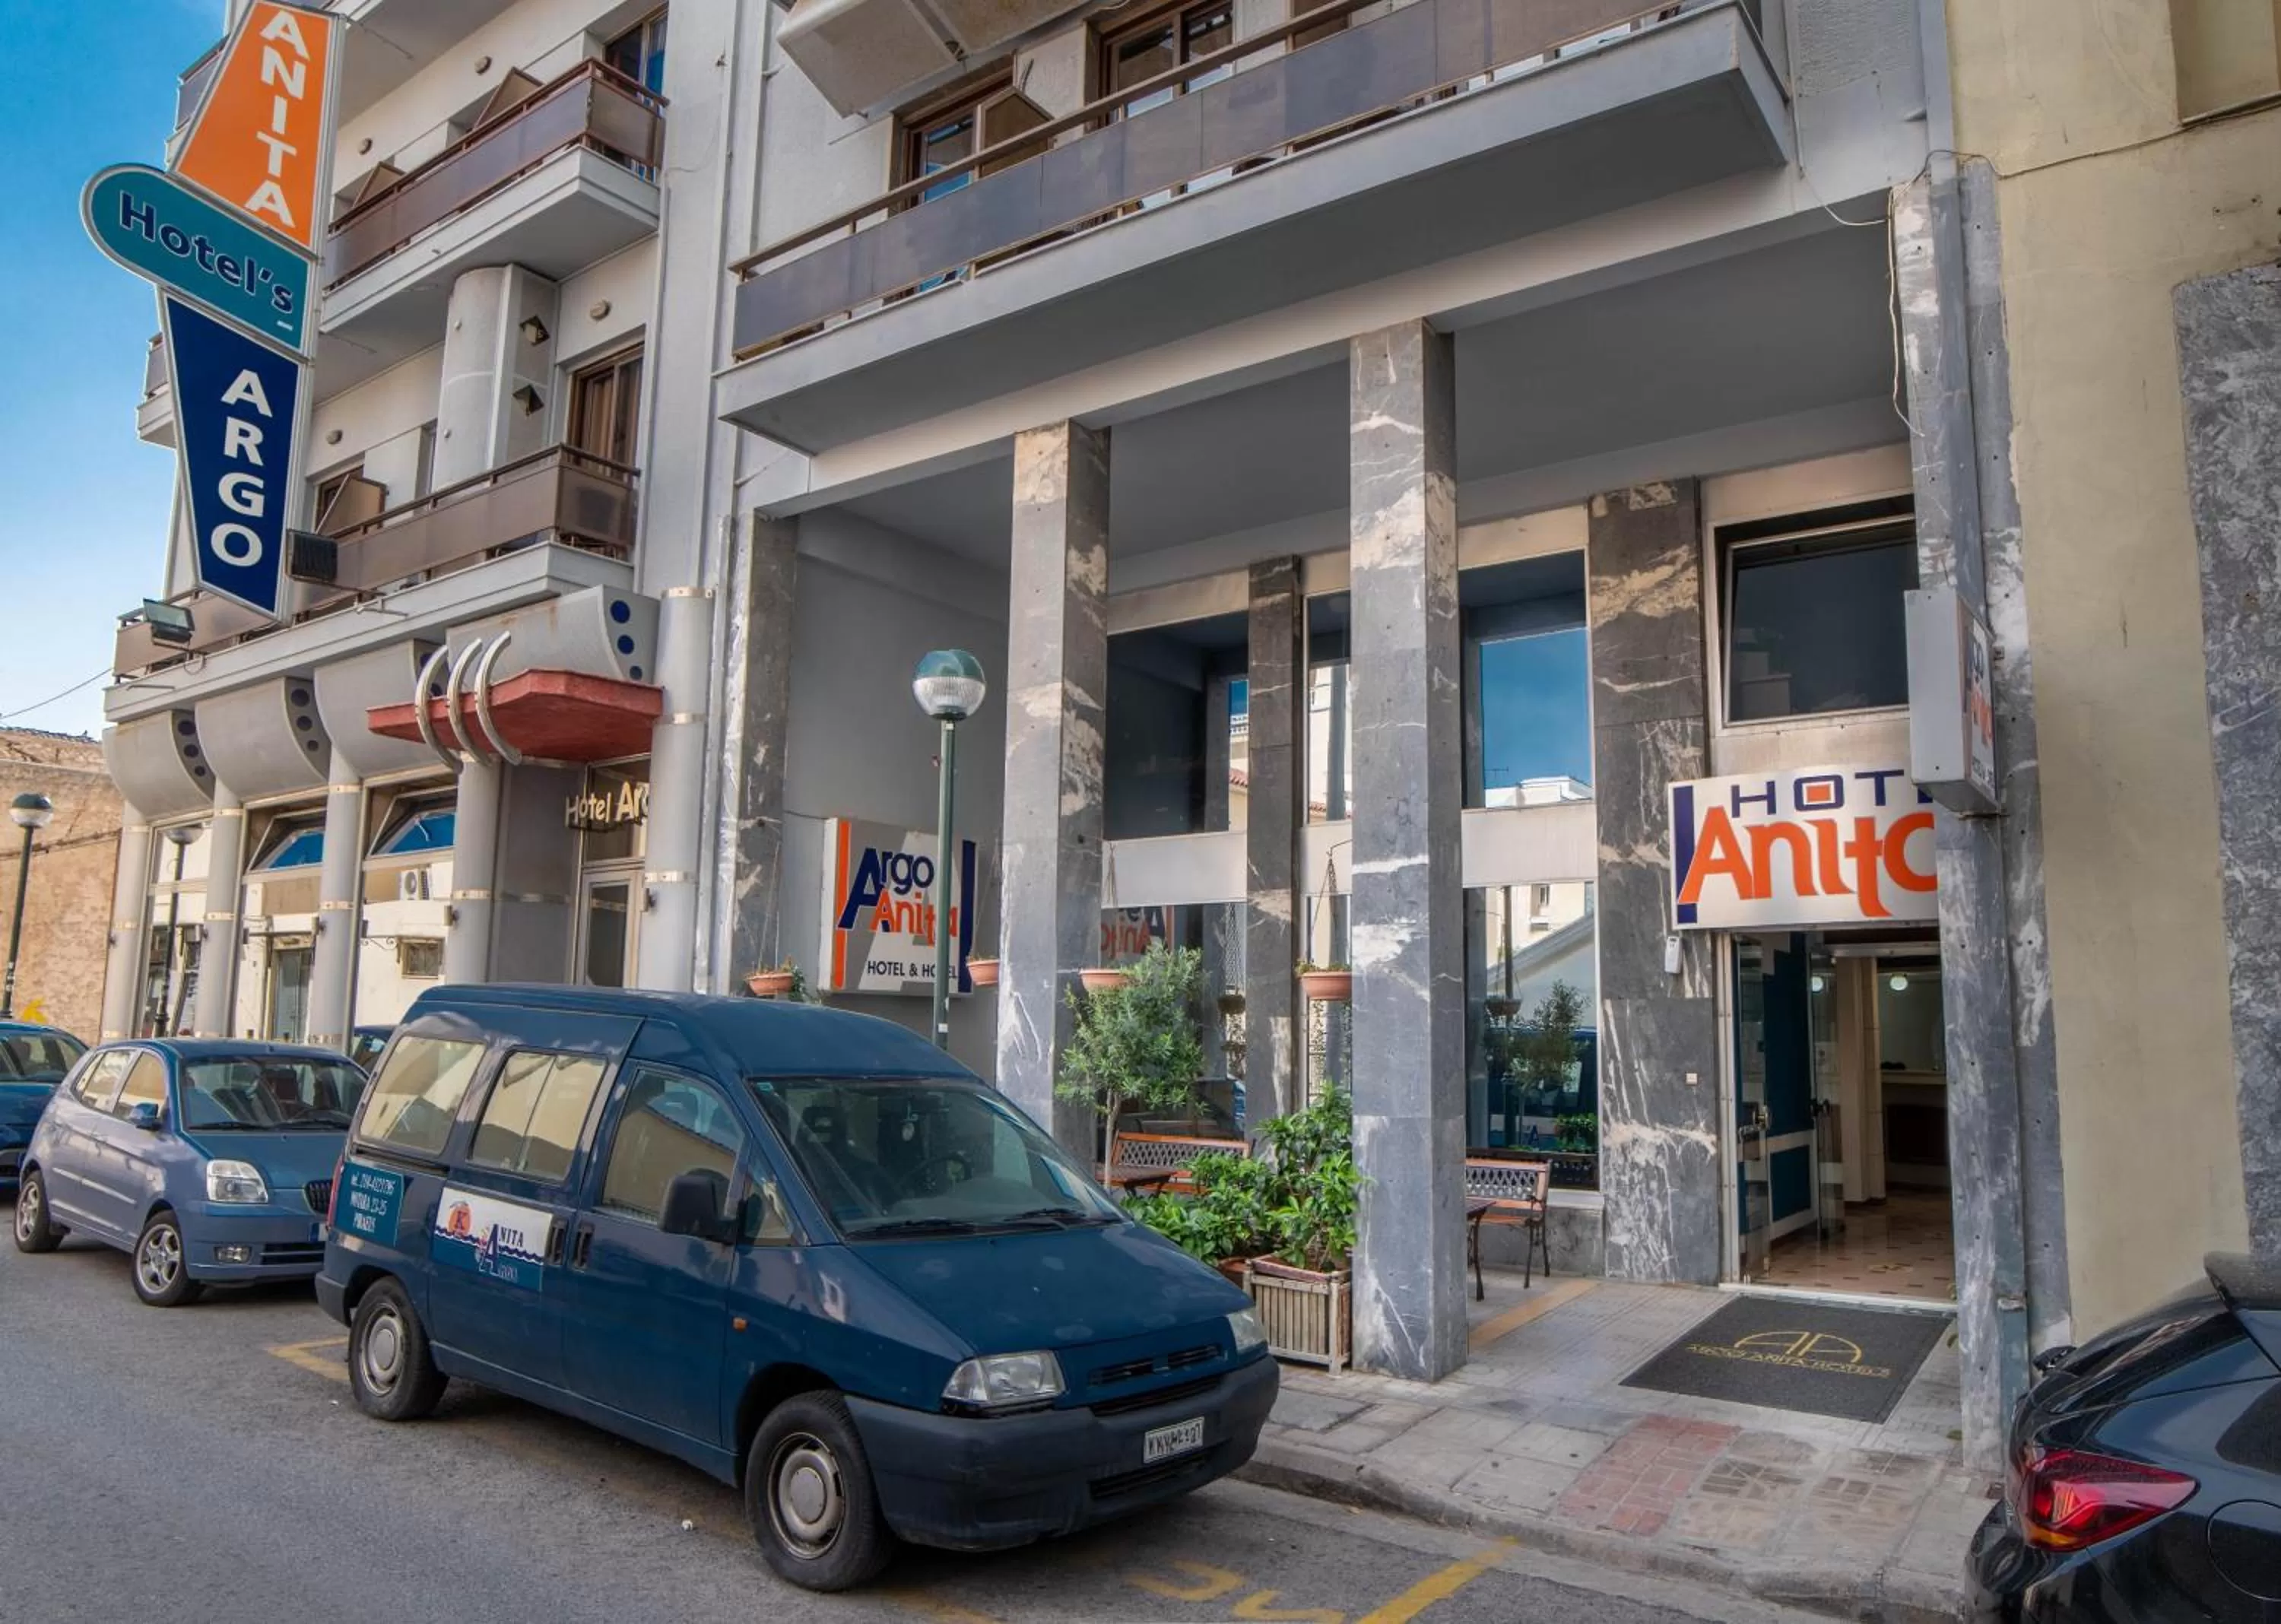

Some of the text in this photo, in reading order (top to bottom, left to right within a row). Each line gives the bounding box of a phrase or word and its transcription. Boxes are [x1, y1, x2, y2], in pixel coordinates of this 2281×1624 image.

[244, 9, 310, 228] ANITA
[119, 191, 294, 315] Hotel's
[211, 368, 274, 568] ARGO
[565, 791, 611, 827] Hotel
[1731, 769, 1934, 819] HOT
[837, 848, 934, 929] Argo
[868, 960, 906, 977] HOTEL
[909, 962, 918, 978] &
